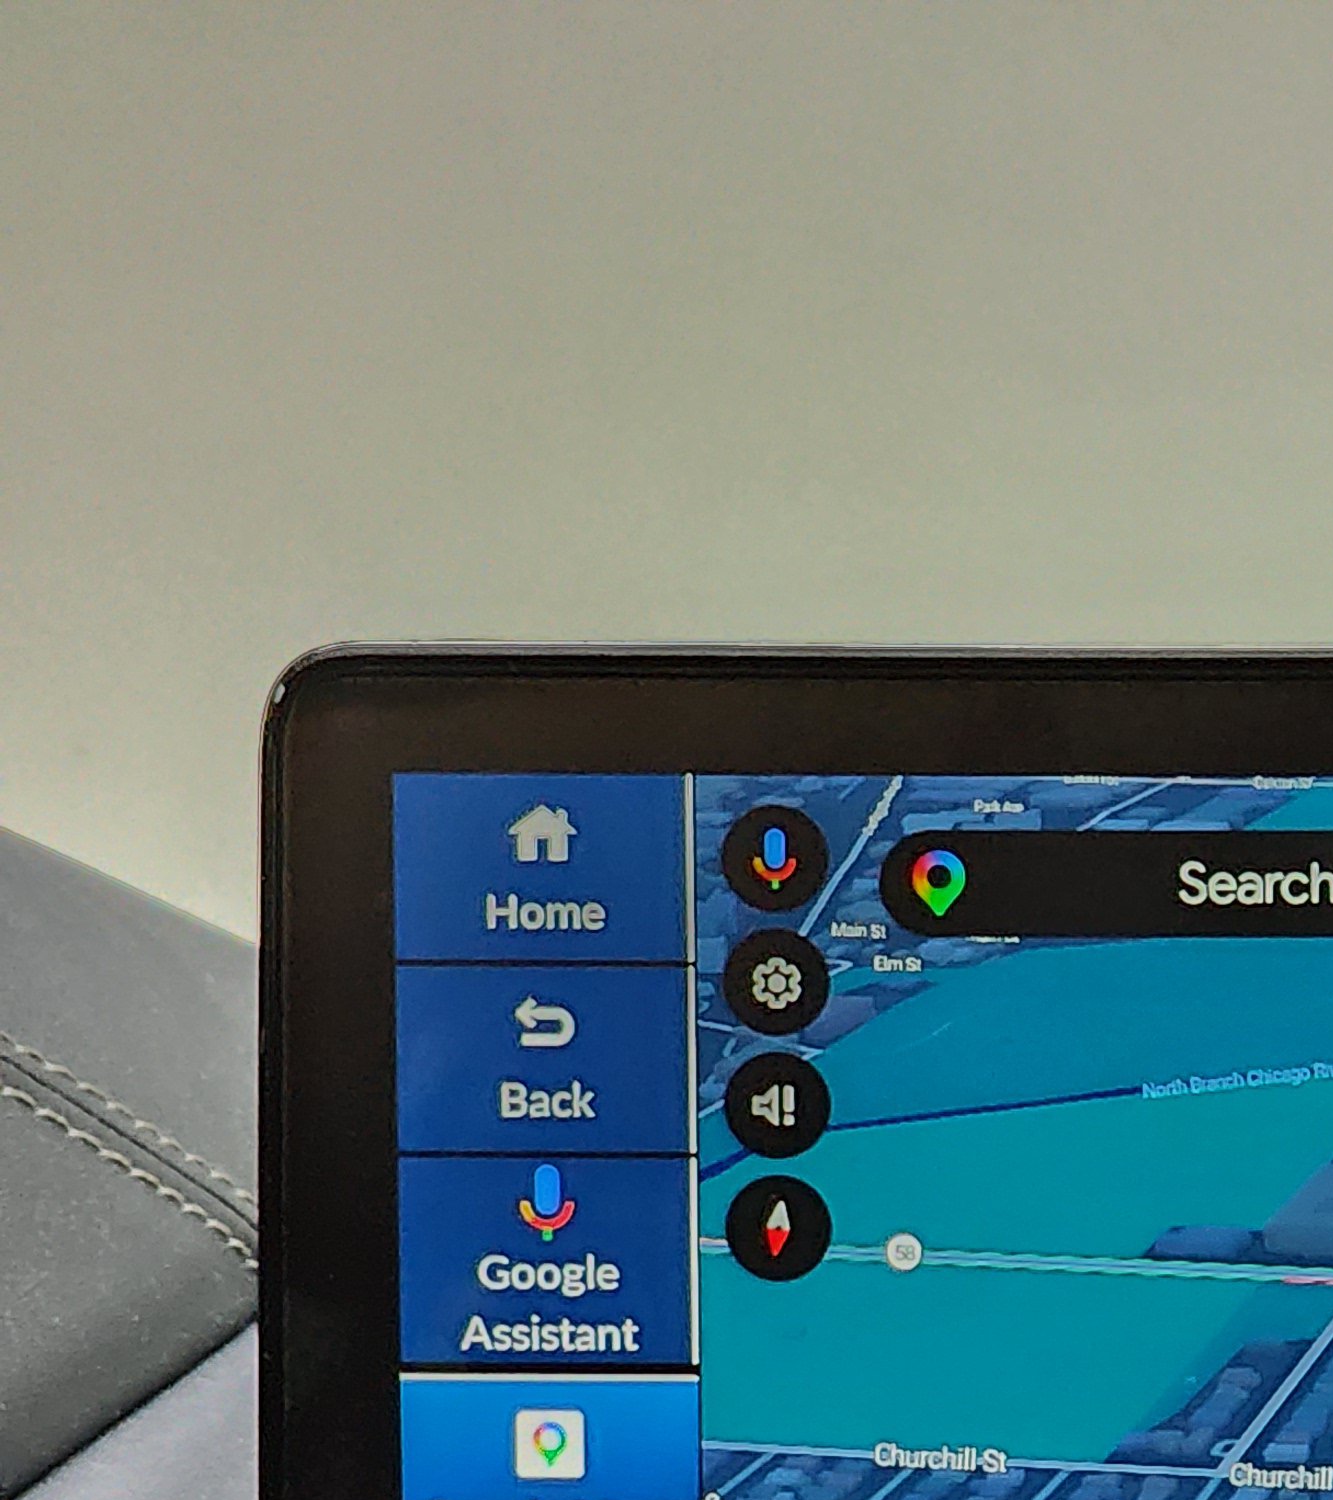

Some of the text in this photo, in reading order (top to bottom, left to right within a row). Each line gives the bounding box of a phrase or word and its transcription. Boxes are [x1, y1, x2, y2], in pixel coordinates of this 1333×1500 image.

[486, 892, 607, 930] Home
[904, 957, 923, 972] St
[1142, 1078, 1188, 1099] North
[1189, 1071, 1245, 1094] Branch
[1246, 1067, 1311, 1087] Chicago
[500, 1081, 597, 1120] Back
[894, 1245, 914, 1261] 58
[478, 1253, 620, 1298] Google
[460, 1314, 640, 1352] Assistant
[873, 1442, 1009, 1474] Churchill St
[1228, 1462, 1333, 1492] Churchill
